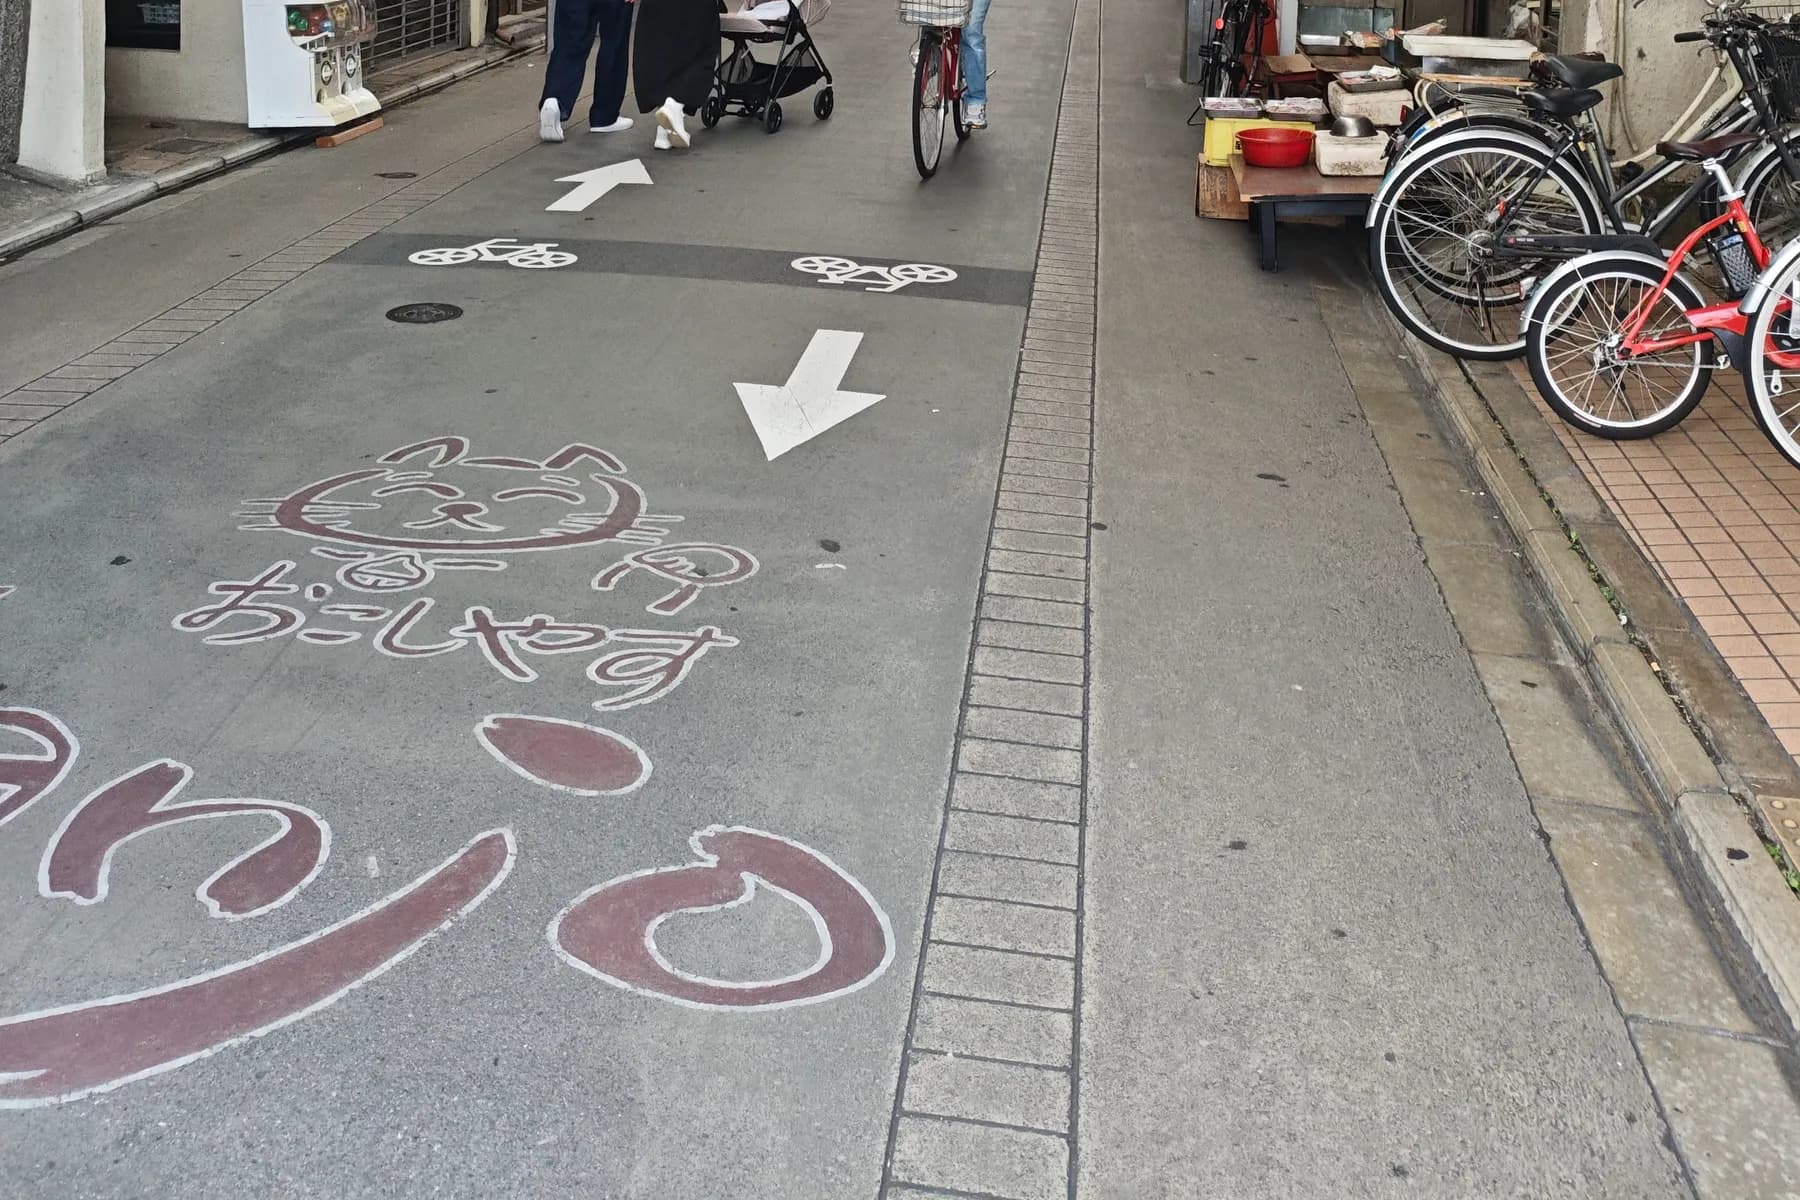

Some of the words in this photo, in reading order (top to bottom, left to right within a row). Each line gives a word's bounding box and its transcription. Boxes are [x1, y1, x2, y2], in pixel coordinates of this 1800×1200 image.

[172, 560, 741, 711] おこしやす
